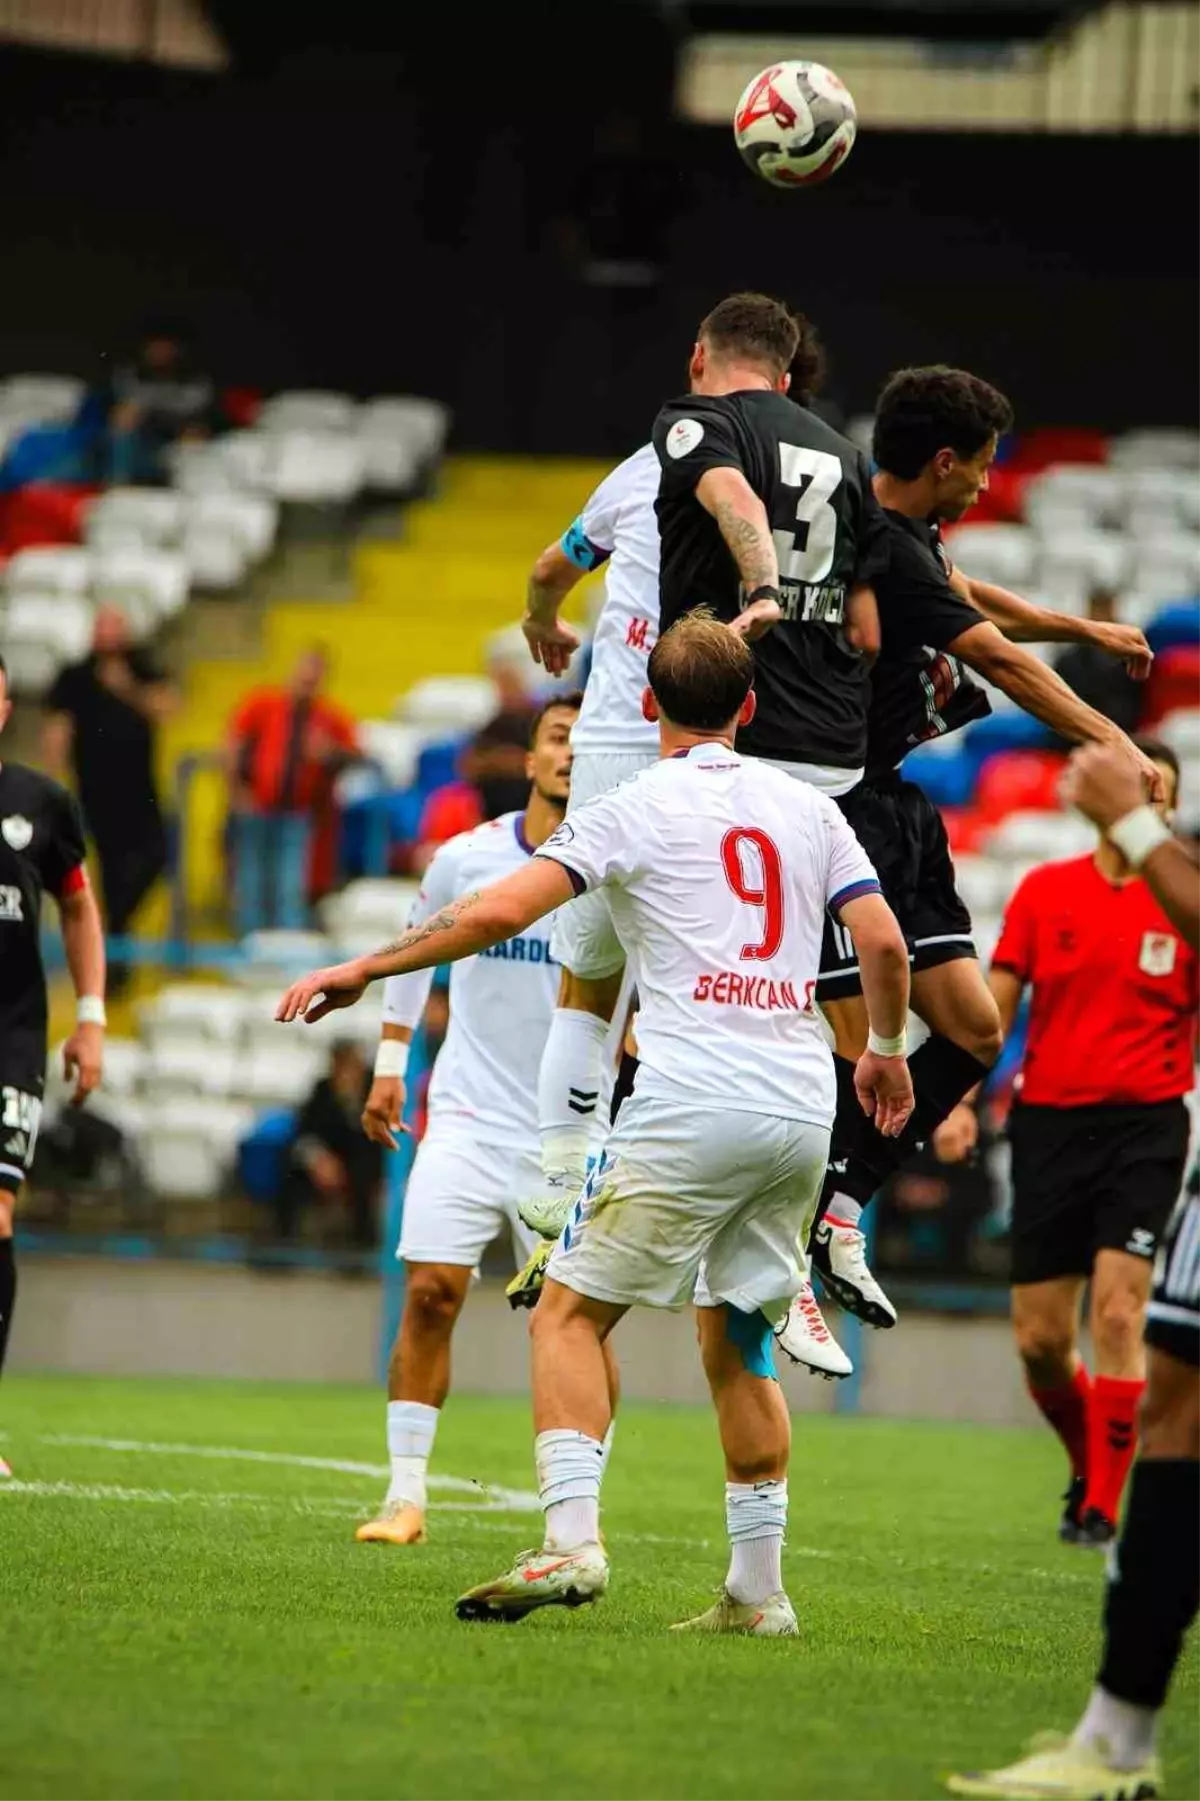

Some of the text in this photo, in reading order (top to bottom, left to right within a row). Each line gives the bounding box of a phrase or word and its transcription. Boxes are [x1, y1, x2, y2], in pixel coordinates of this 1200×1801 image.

[772, 441, 843, 584] 3
[720, 826, 785, 961] 9
[693, 972, 799, 1010] BERKCAN
